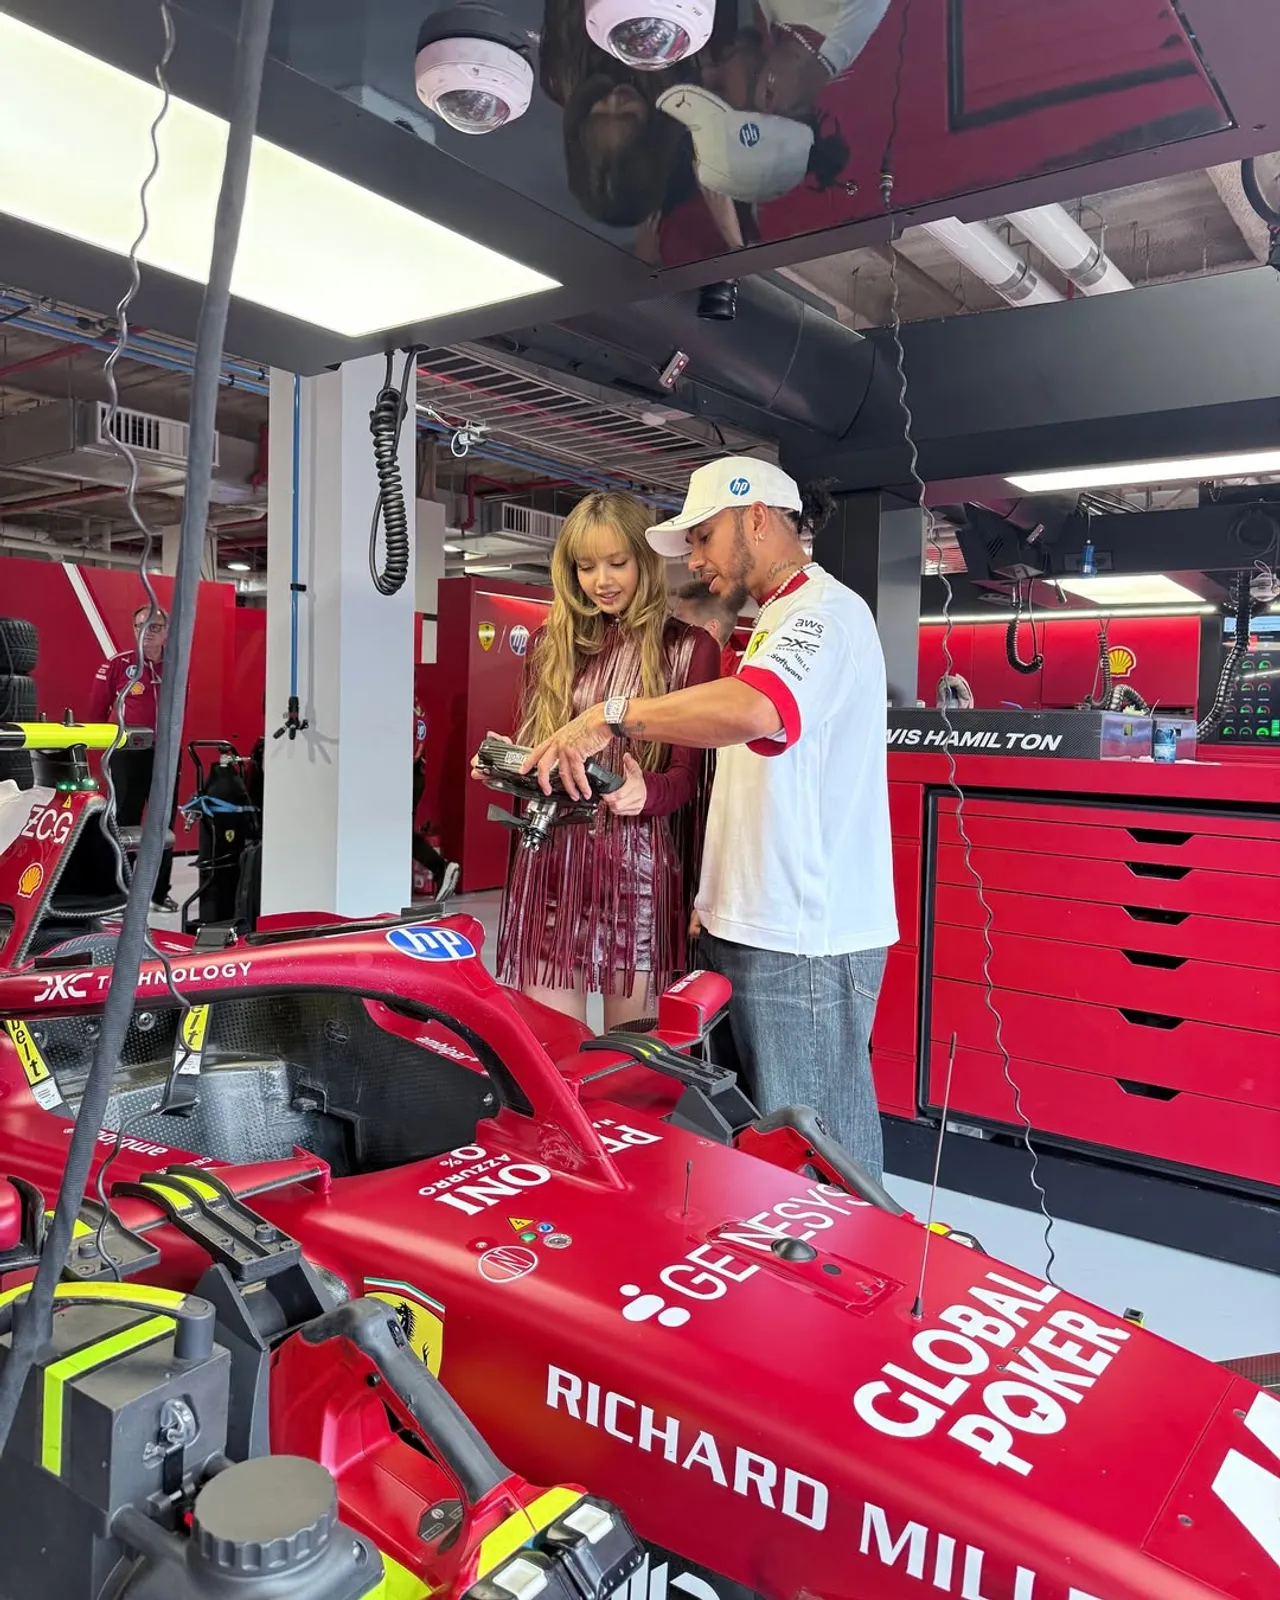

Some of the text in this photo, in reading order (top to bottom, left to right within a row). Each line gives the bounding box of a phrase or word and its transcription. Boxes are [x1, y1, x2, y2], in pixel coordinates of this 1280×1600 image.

[731, 477, 749, 498] hp
[795, 618, 825, 635] aws
[923, 730, 1063, 751] HAMILTON
[397, 927, 463, 959] hp
[34, 961, 252, 1003] DXC THNOLOGY
[418, 1153, 511, 1196] AZZURRO
[659, 1183, 874, 1301] GENESYS
[853, 1271, 1062, 1438] GLOBAL
[947, 1309, 1132, 1477] POKER
[546, 1364, 1106, 1600] RICHARD MILL
